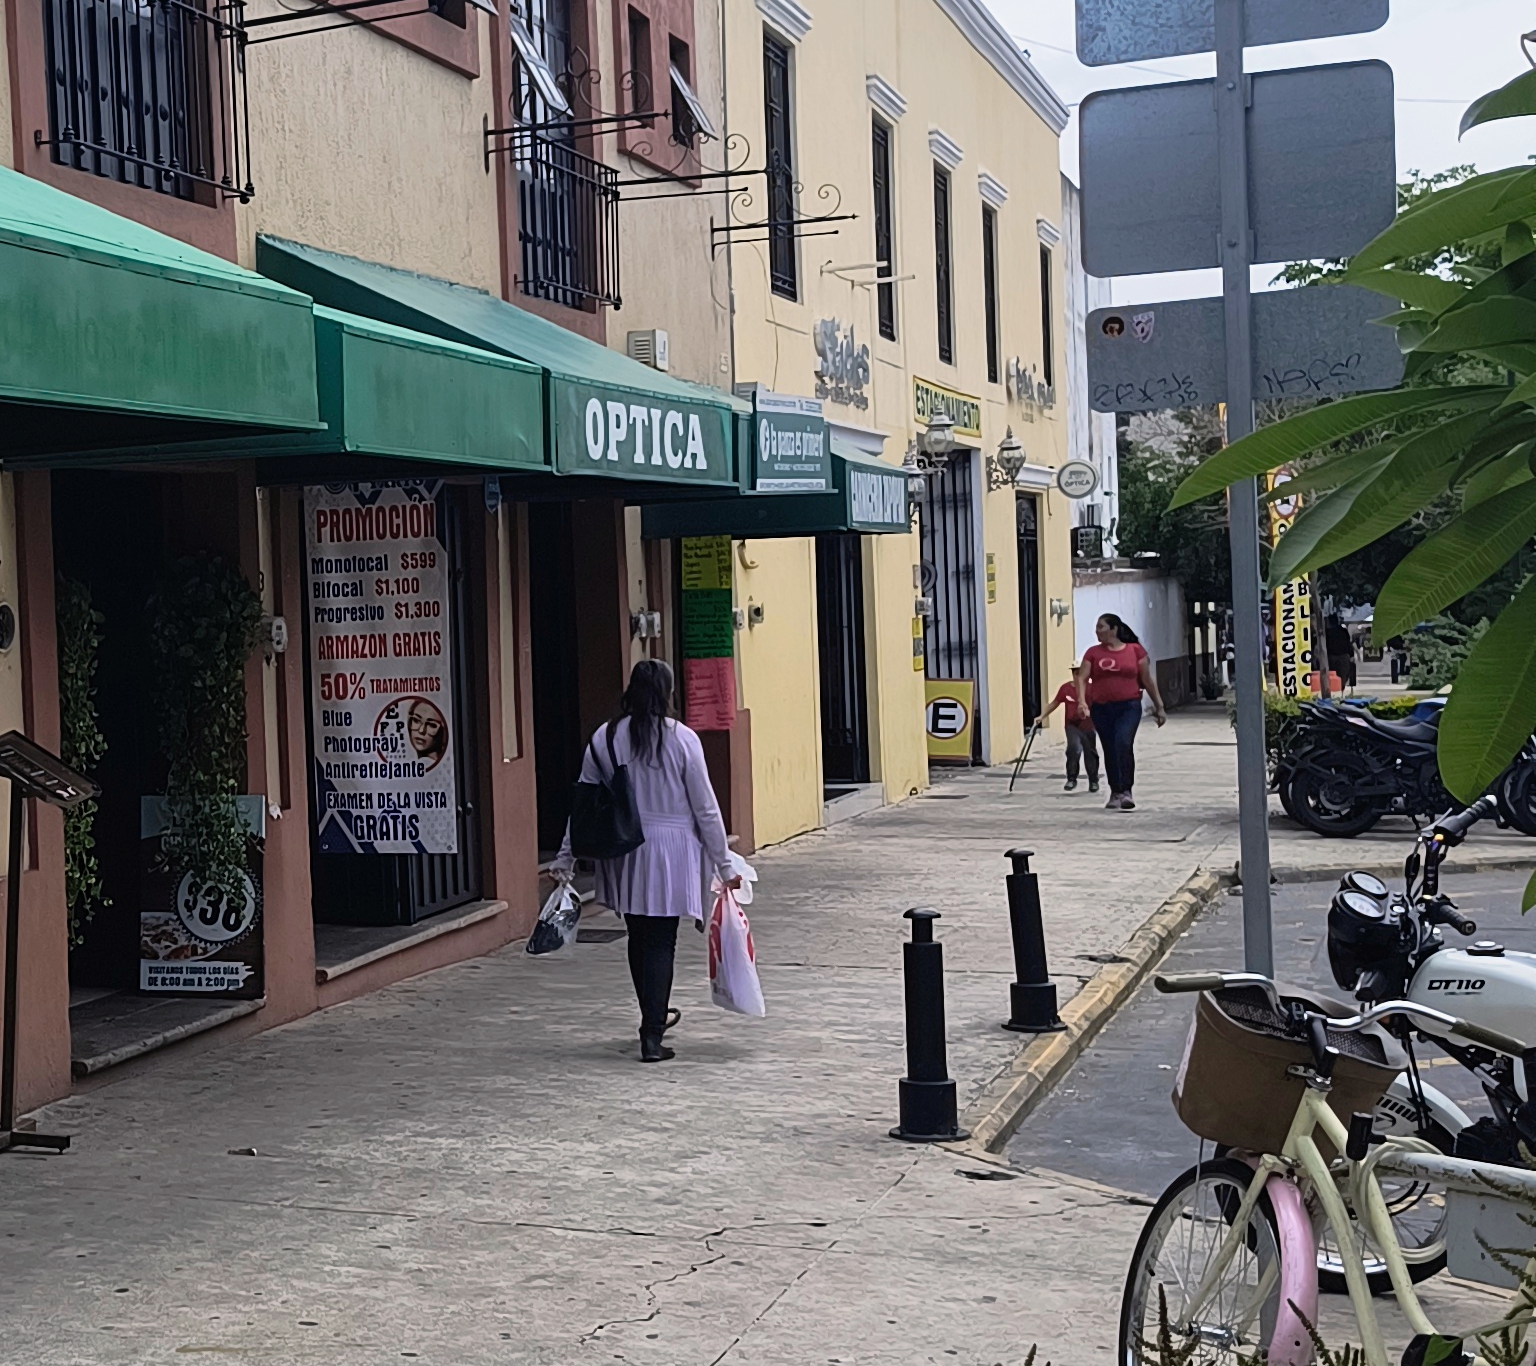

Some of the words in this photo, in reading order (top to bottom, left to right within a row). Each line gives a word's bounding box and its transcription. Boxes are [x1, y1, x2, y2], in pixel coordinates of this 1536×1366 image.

[586, 397, 707, 470] OPTICA
[317, 495, 435, 543] PROMOCIÓN
[312, 554, 388, 574] Monofocal
[400, 552, 436, 570] $599
[313, 580, 364, 598] Bifocal
[314, 604, 384, 623] Progresivo
[319, 634, 387, 660] ARMAZON
[393, 631, 441, 657] GRATIS
[321, 672, 366, 700] 50%
[370, 677, 441, 693] TRATAMIENTOS
[323, 710, 352, 727] Blue
[931, 702, 958, 734] E
[324, 736, 399, 754] Photogray
[325, 761, 425, 779] Antireflejante
[327, 792, 373, 809] EXAMEN
[378, 792, 394, 809] DE
[397, 792, 411, 808] LA
[415, 791, 447, 808] VISTA
[353, 814, 420, 841] GRATIS
